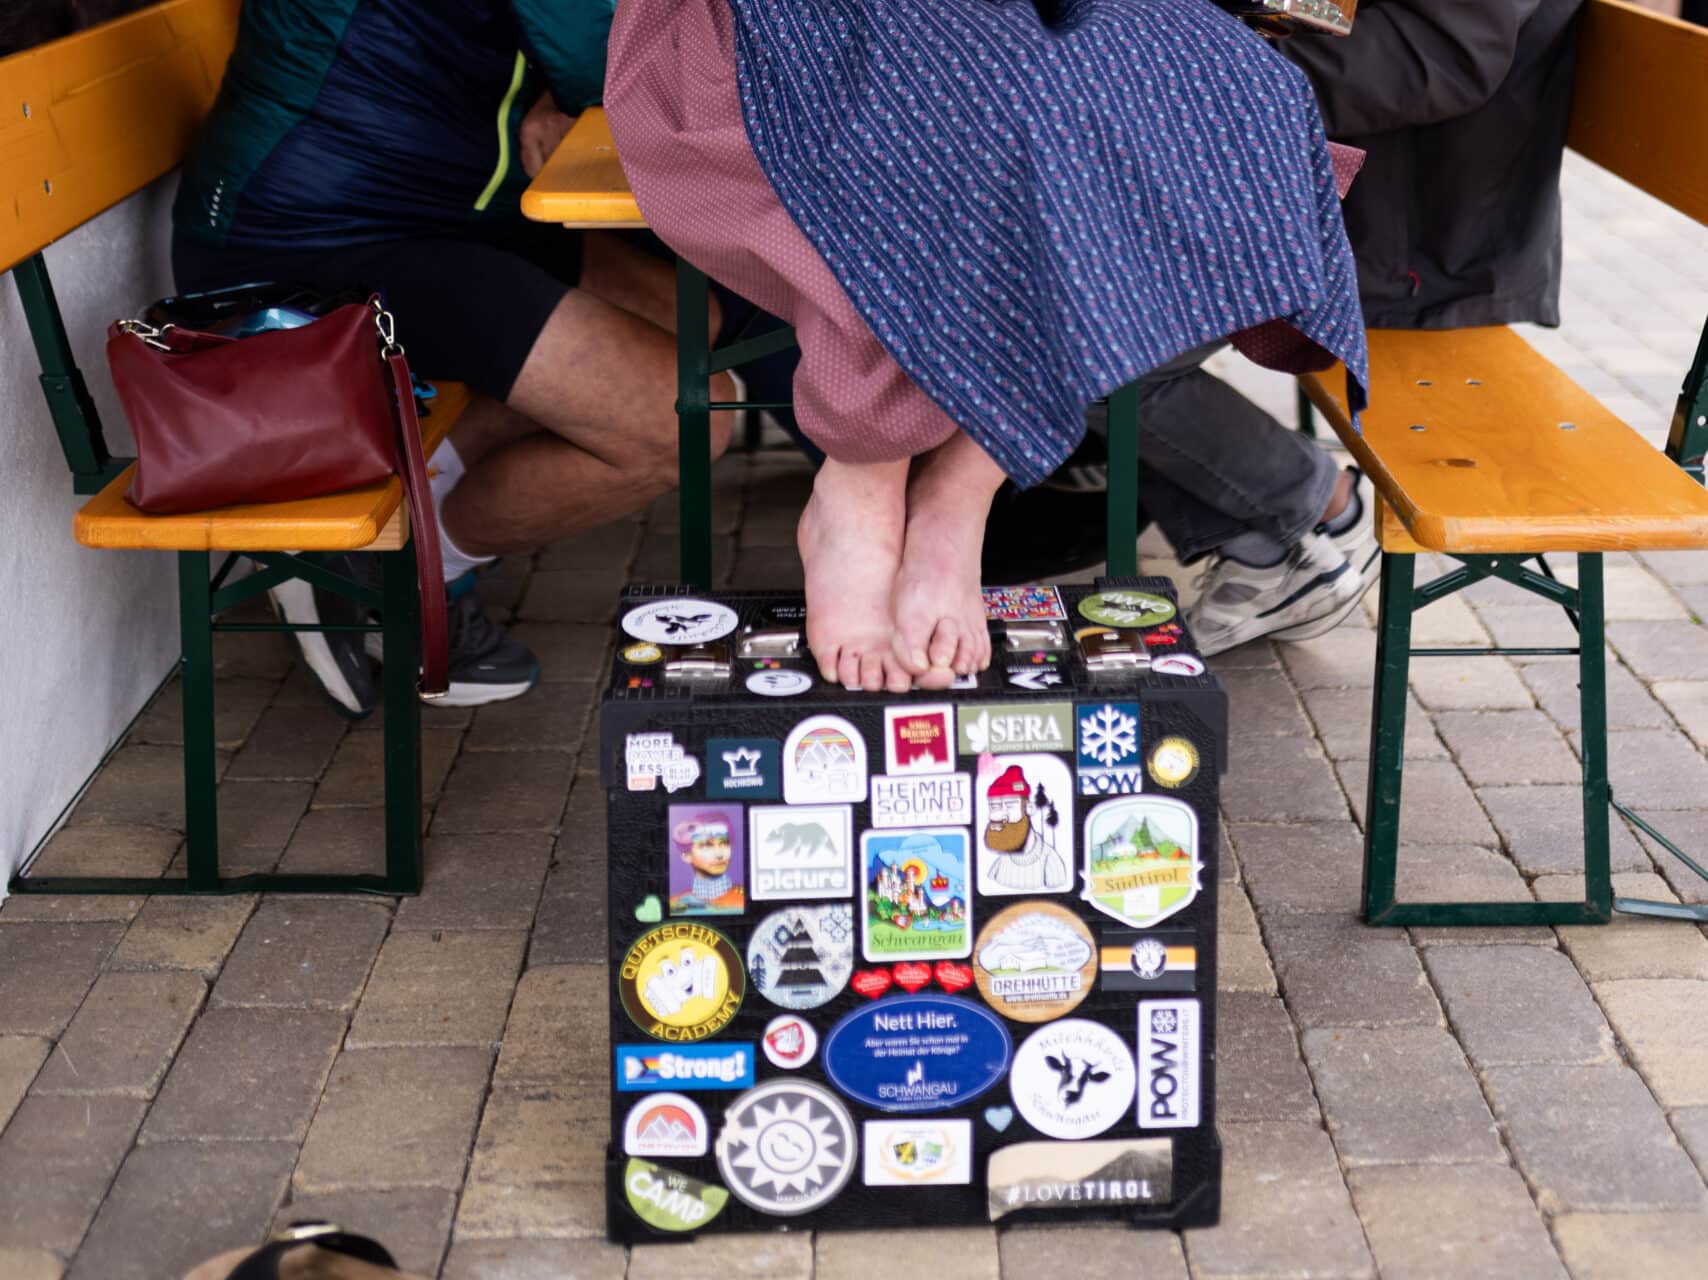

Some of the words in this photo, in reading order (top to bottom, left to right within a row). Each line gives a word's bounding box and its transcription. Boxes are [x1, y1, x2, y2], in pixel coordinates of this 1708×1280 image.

[990, 714, 1062, 742] SERA
[629, 738, 669, 749] MORE
[629, 763, 663, 776] LESS
[1080, 774, 1141, 794] POW
[758, 868, 845, 893] picture
[622, 924, 720, 980] QUETSCHN
[650, 989, 740, 1040] ACADEMY
[874, 1013, 912, 1031] Nett
[916, 1011, 957, 1030] Hier.
[659, 1051, 745, 1082] Strong!
[1151, 1038, 1177, 1119] POW
[878, 1081, 957, 1098] SCHWANGAU
[668, 1175, 688, 1193] WE
[1007, 1180, 1152, 1205] #LOVETIROL
[630, 1171, 706, 1224] CAMP
